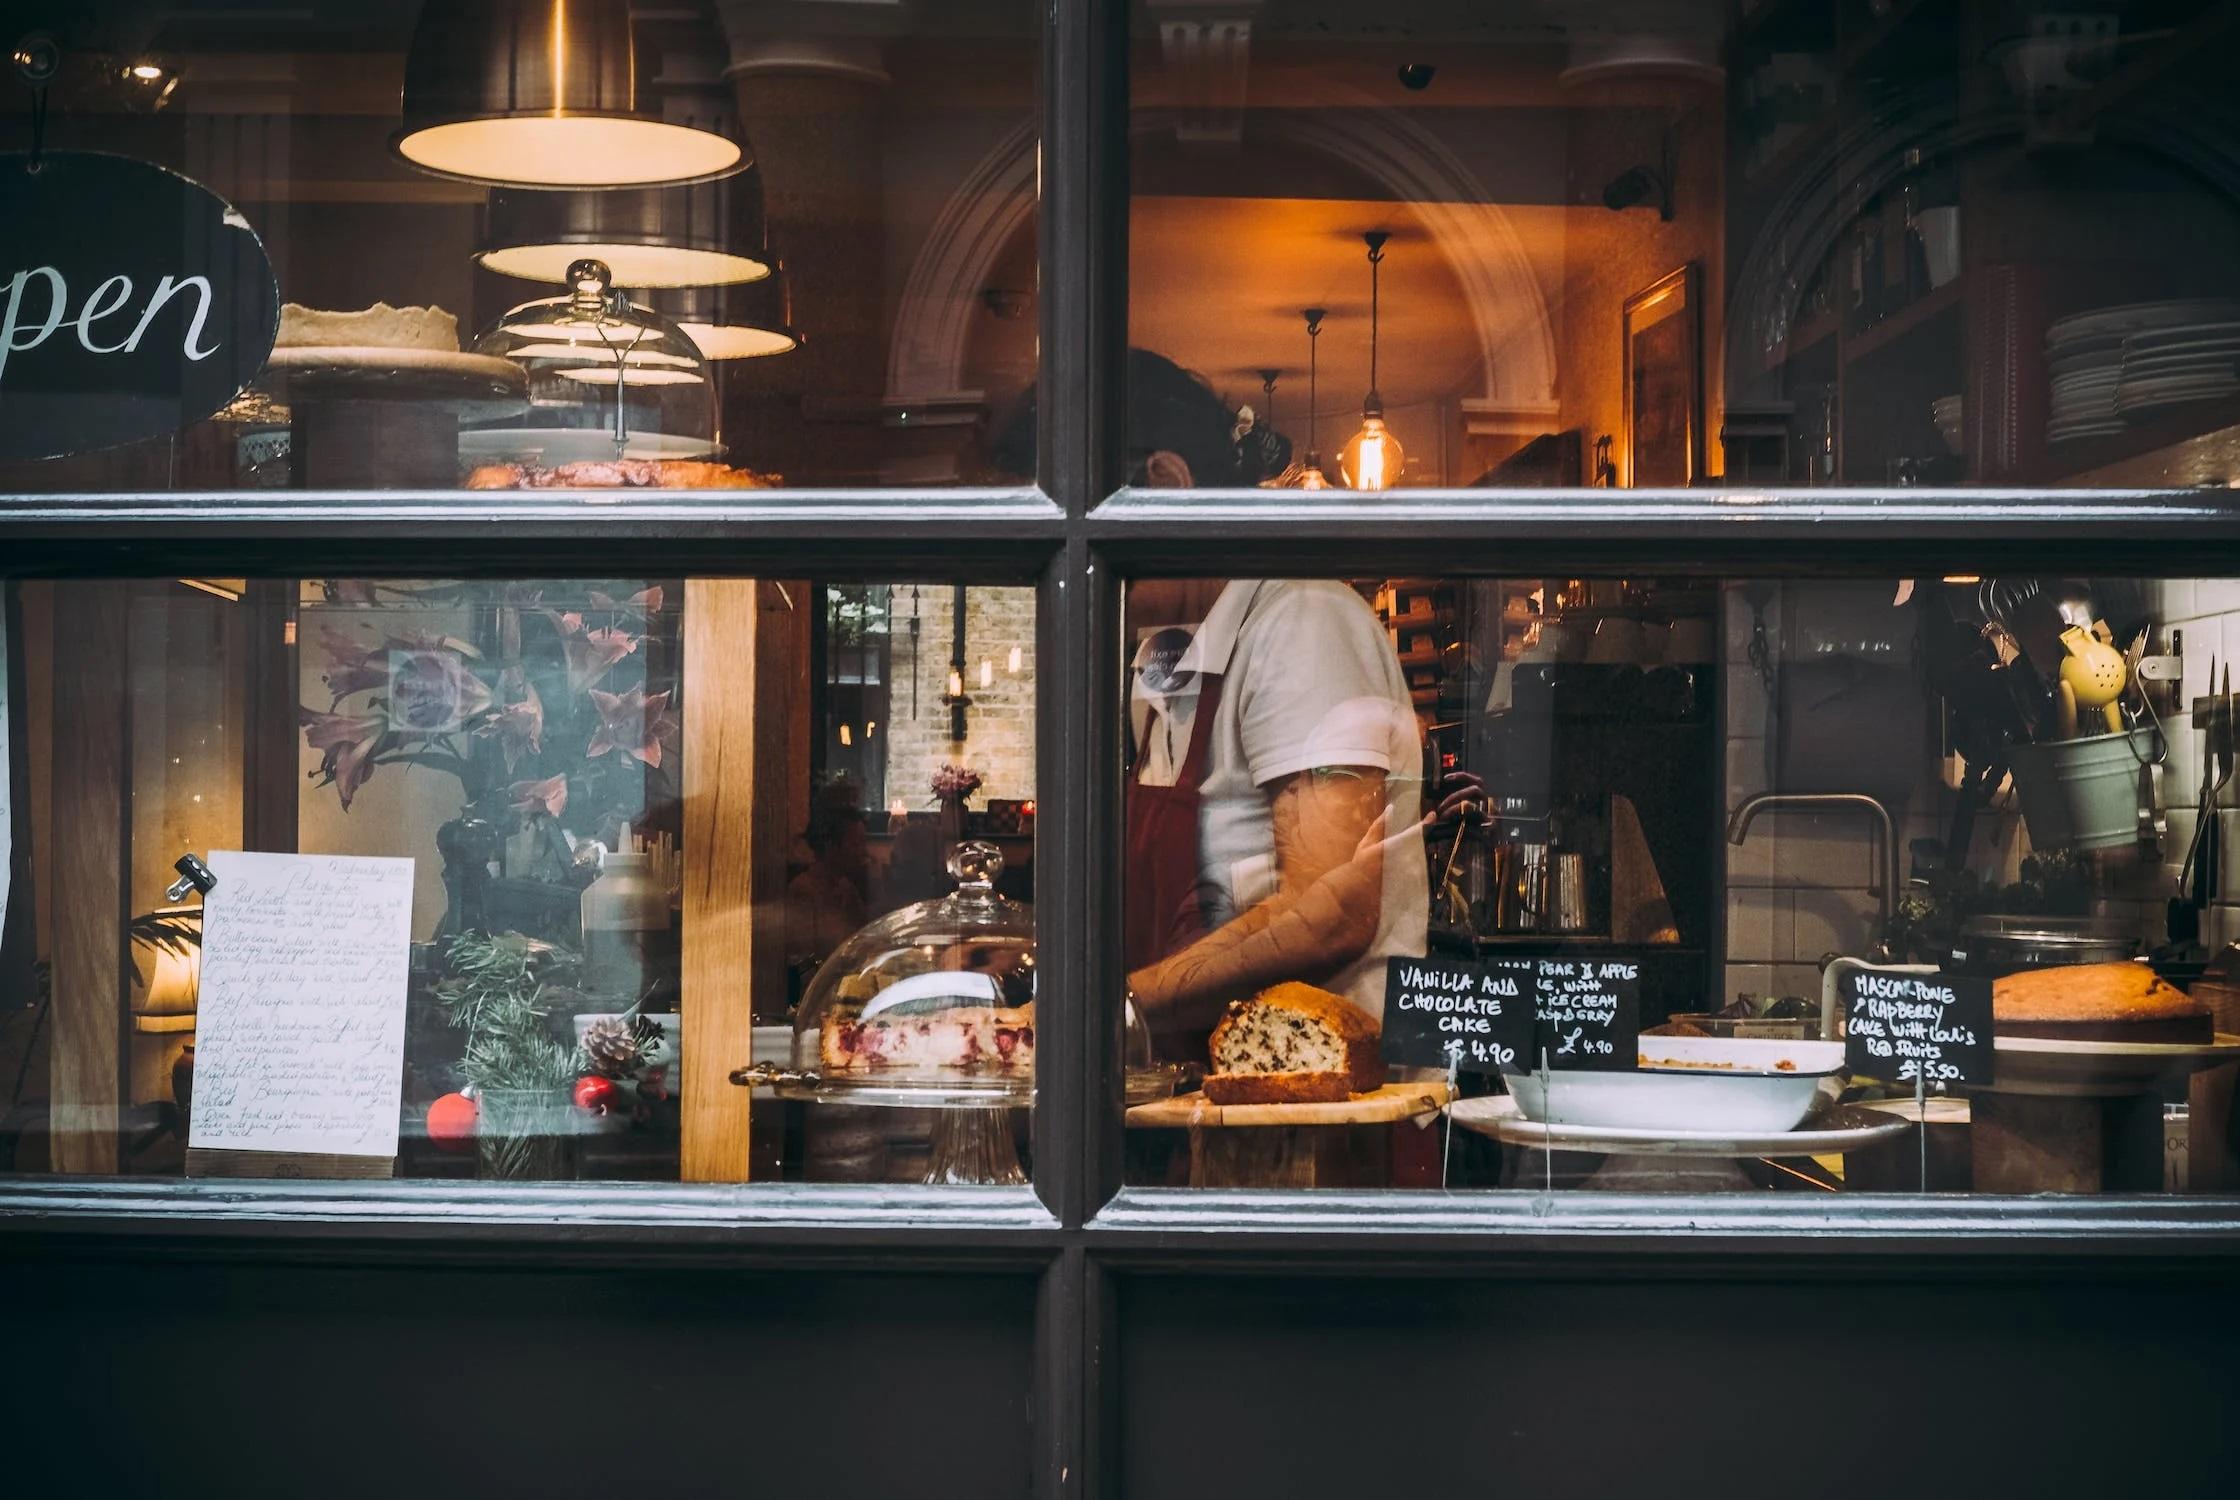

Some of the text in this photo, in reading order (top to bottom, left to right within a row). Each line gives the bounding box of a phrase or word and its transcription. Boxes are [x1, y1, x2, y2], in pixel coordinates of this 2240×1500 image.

[0, 266, 221, 381] pen
[1539, 960, 1575, 976] PEAR
[1599, 963, 1638, 980] APPLE
[1482, 976, 1519, 996] AND
[1399, 993, 1502, 1015] CHOCOLATE
[1571, 994, 1617, 1009] CREAM
[1438, 1016, 1491, 1034] CAKE
[1848, 1017, 1886, 1037] CAKE
[1471, 1039, 1515, 1065] 4.90
[1583, 1039, 1613, 1054] 4.90
